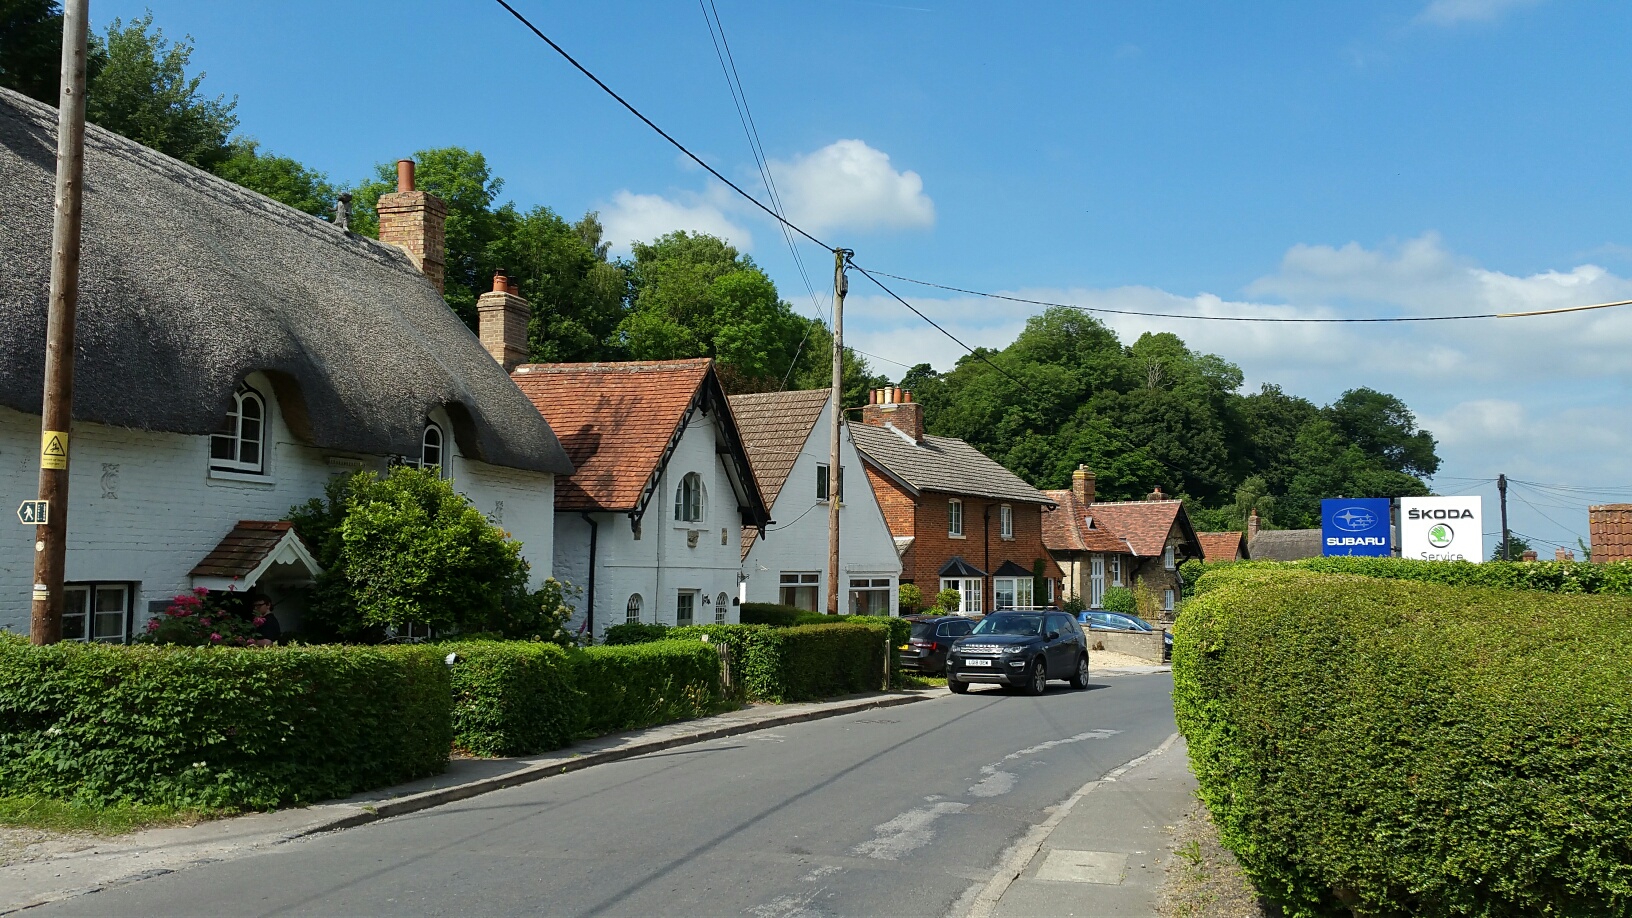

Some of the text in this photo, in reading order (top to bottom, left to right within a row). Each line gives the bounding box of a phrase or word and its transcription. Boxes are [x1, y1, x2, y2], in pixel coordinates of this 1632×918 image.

[1408, 507, 1474, 520] ŠKODA
[1326, 537, 1385, 546] SUBARU
[1420, 551, 1464, 561] Service
